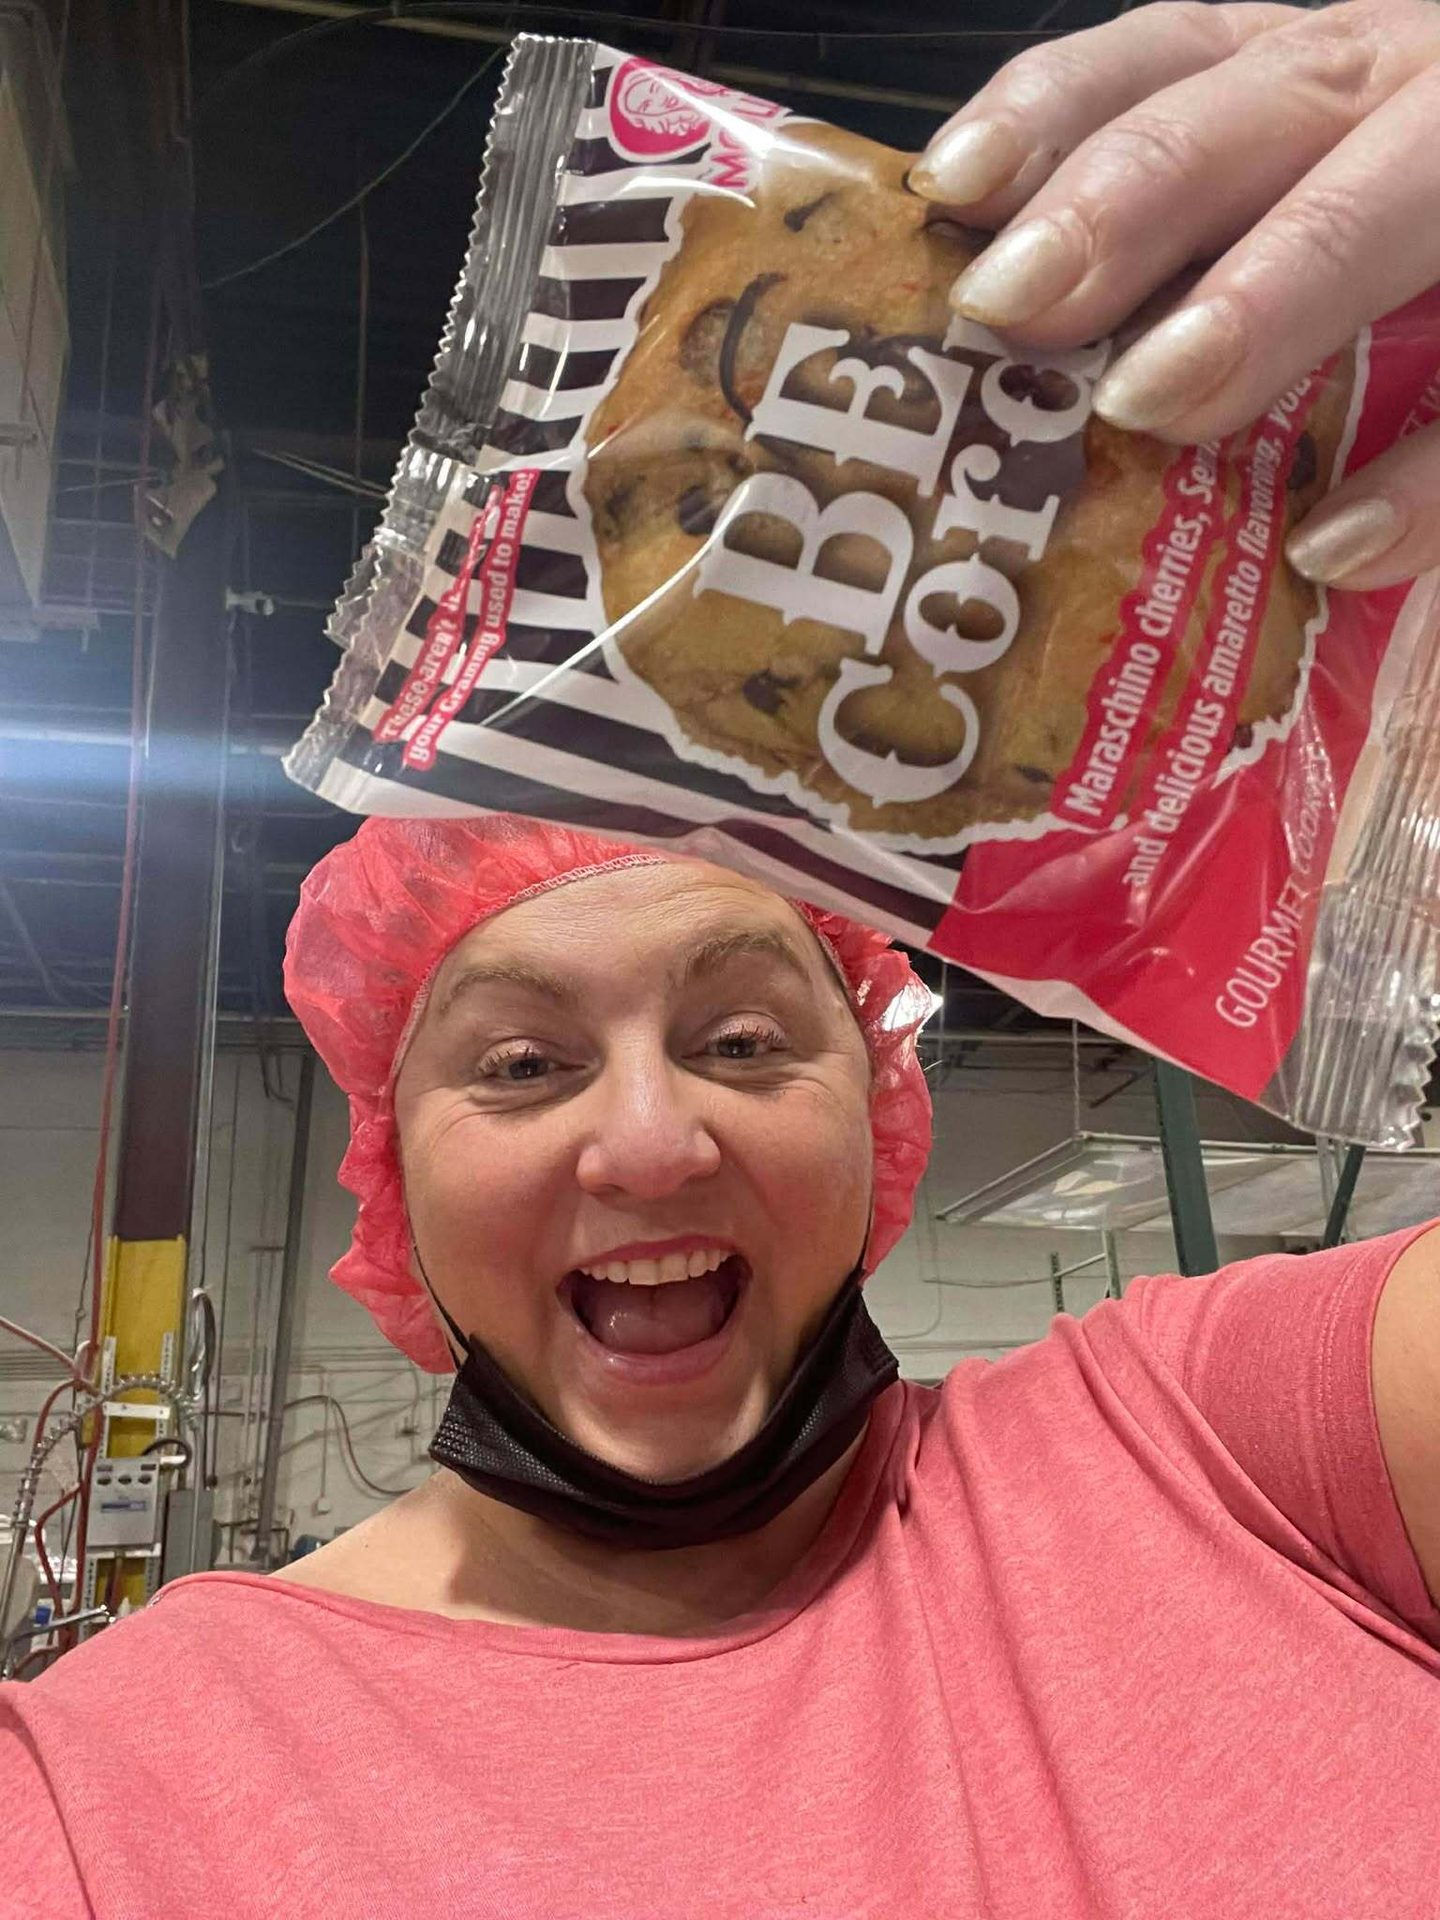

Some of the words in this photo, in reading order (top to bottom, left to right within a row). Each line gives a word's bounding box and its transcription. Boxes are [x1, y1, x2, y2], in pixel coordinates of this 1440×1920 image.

[693, 322, 973, 656] BE
[1236, 436, 1286, 561] flavoring,
[491, 541, 513, 567] to
[485, 570, 508, 628] used
[1201, 559, 1262, 698] amaretto
[418, 617, 458, 683] aren't
[440, 631, 501, 712] Grammy
[1065, 641, 1160, 815] Maraschino
[1134, 511, 1213, 640] cherries,
[408, 711, 445, 763] your
[1143, 698, 1226, 834] delicious
[1122, 828, 1168, 889] and
